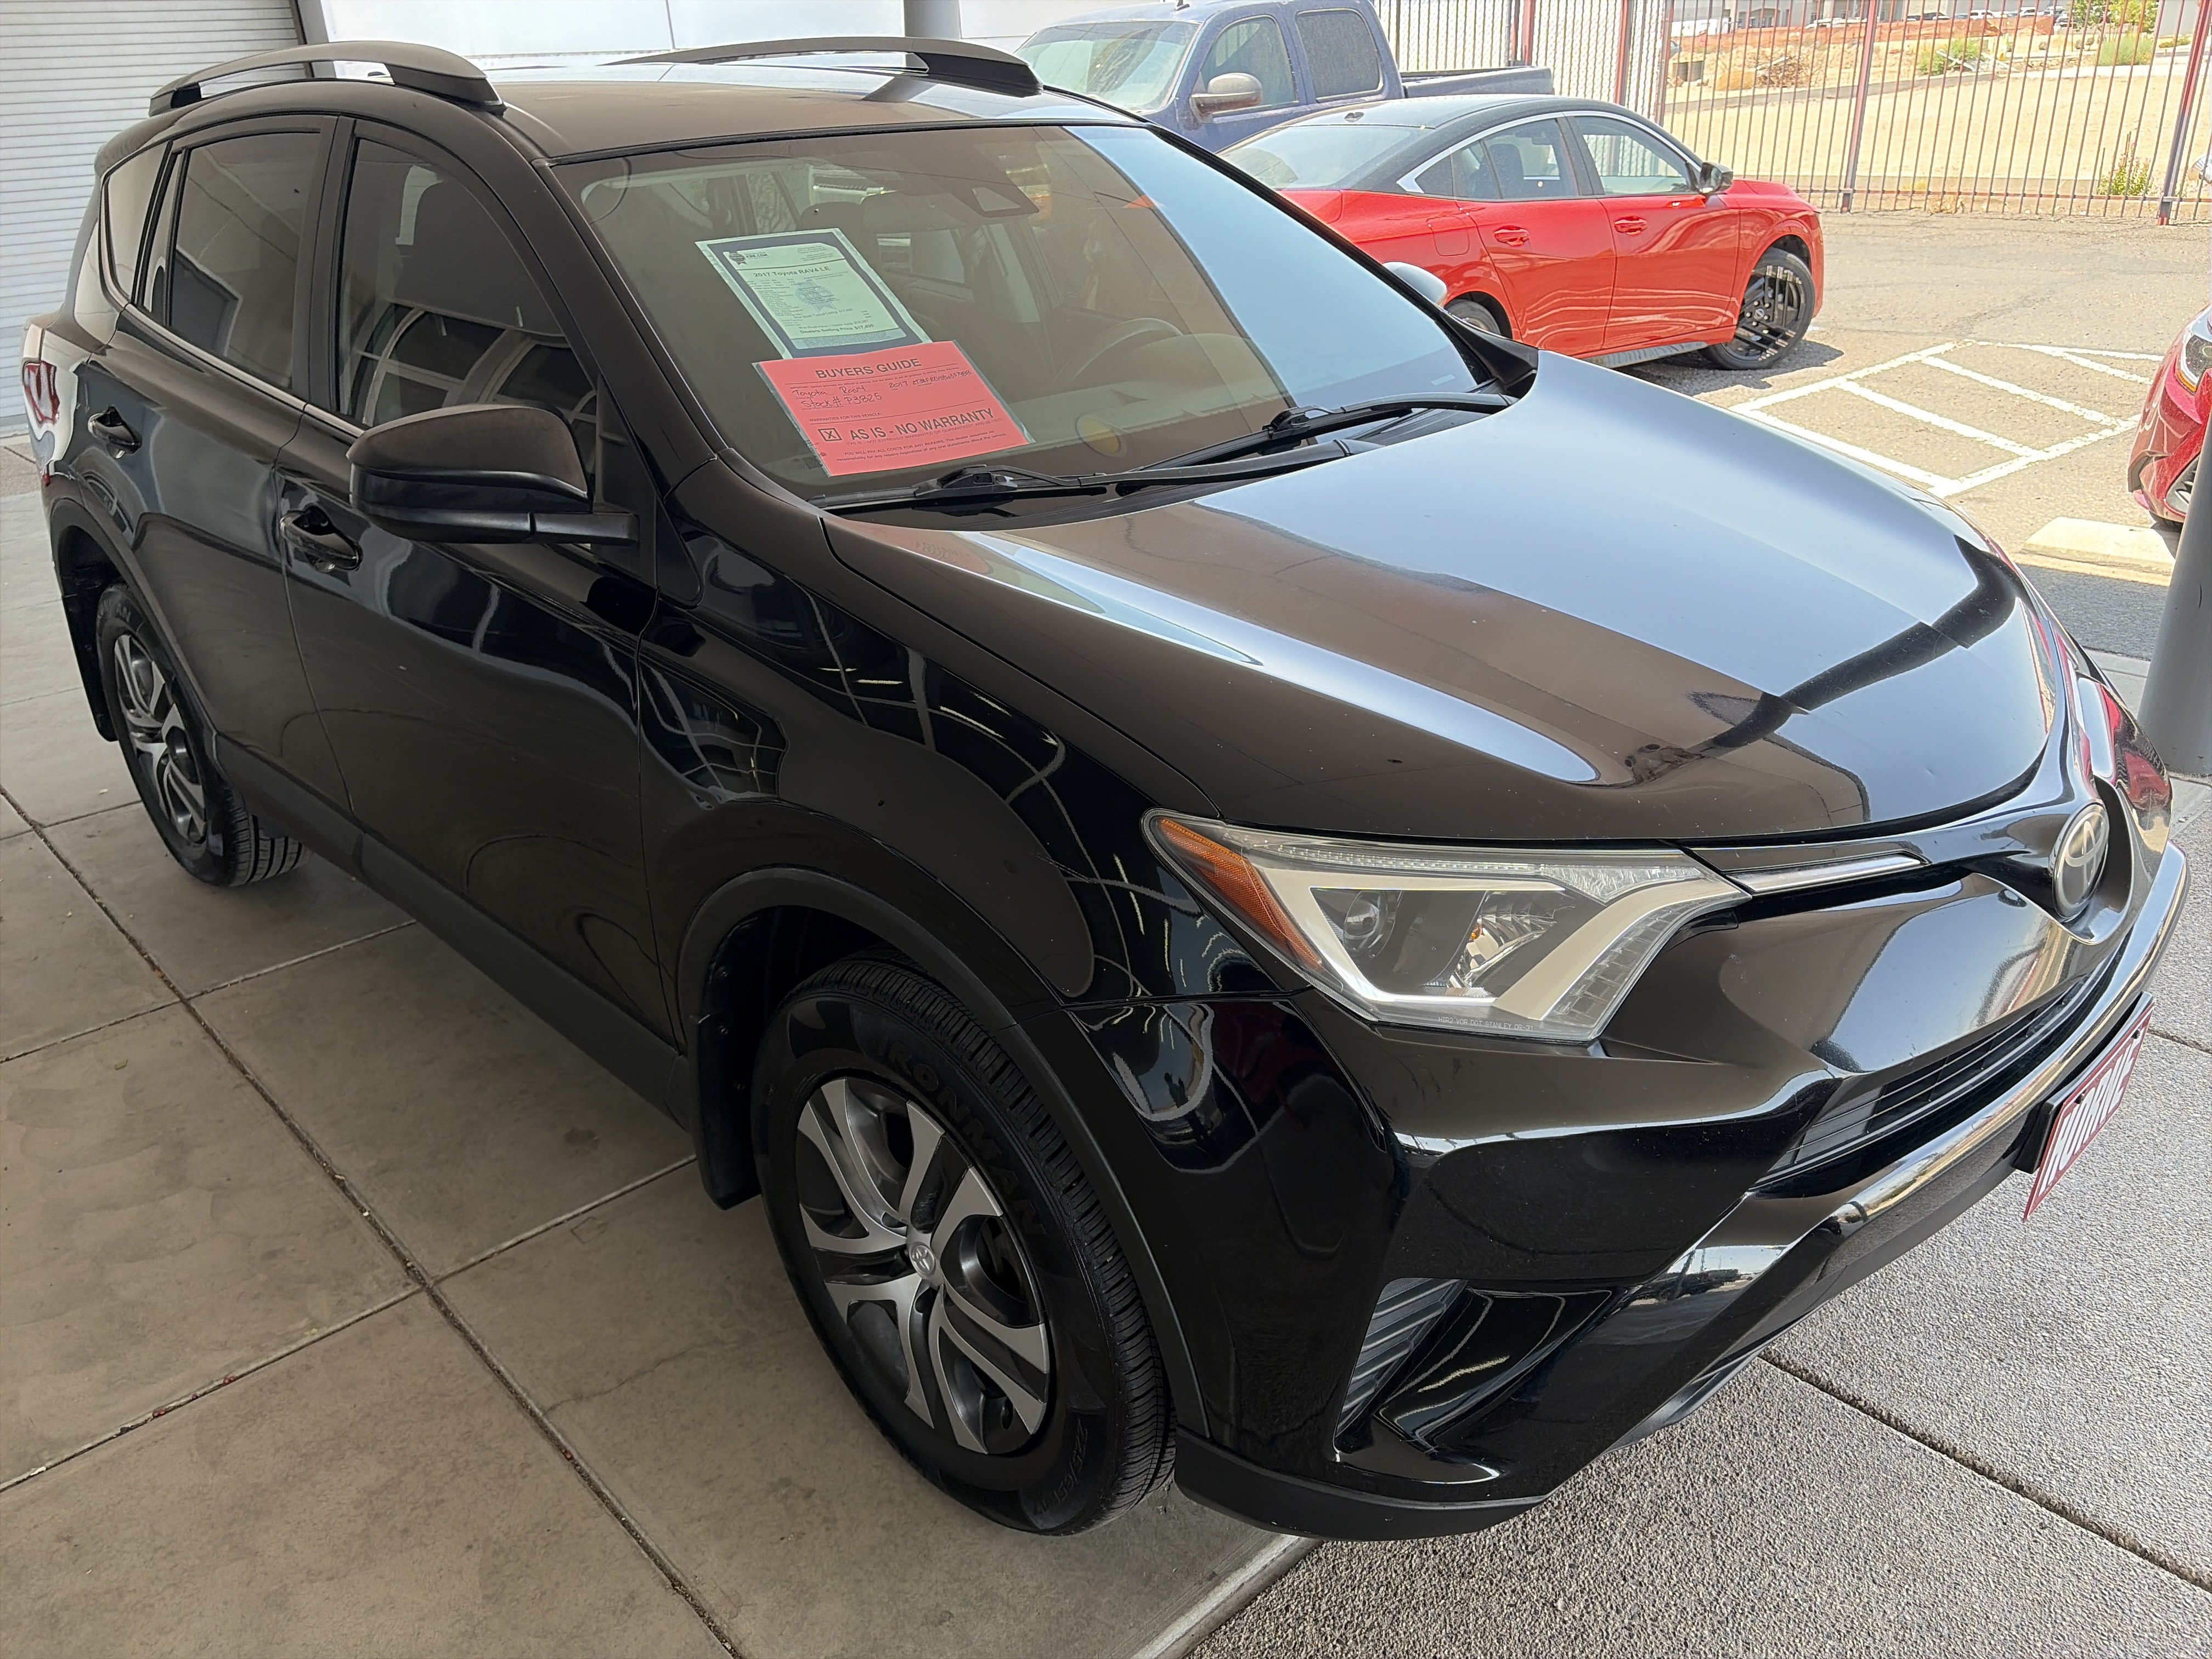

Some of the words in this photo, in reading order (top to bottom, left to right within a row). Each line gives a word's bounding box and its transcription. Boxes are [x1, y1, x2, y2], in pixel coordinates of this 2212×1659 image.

[816, 366, 874, 379] BUYERS
[876, 358, 922, 373] GUIDE
[792, 389, 828, 397] Toyota
[839, 385, 866, 394] Rav4
[844, 392, 883, 405] P3825
[850, 428, 870, 441] AS
[870, 426, 887, 438] IS
[894, 422, 918, 435] NO
[918, 408, 994, 431] WARRANTY
[1485, 1021, 1513, 1029] STANLEY
[2039, 1027, 2145, 1197] HORNE
[877, 1034, 1047, 1238] IRONMAN
